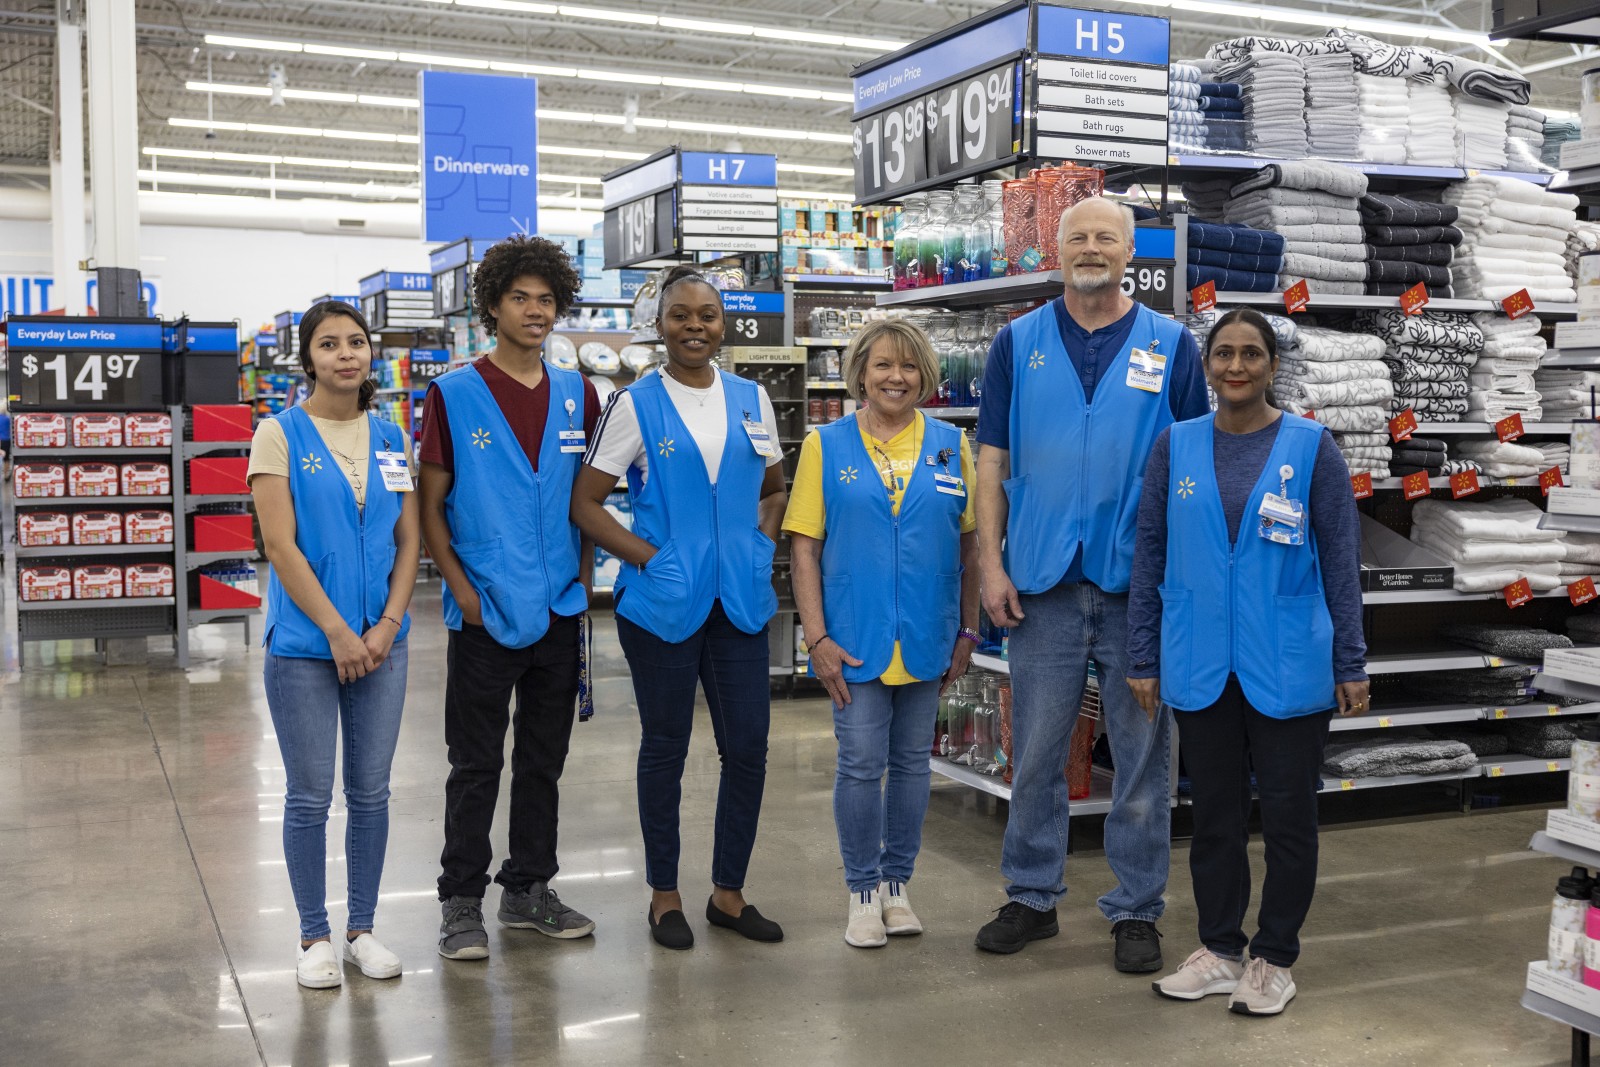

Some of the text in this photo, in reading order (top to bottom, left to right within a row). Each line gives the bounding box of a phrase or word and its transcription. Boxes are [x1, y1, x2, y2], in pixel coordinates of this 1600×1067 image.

[1070, 67, 1137, 83] Toilet lid covers
[858, 66, 922, 100] Everyday Low Price
[1085, 95, 1125, 107] Bath sets
[1082, 120, 1124, 134] Bath rugs
[1075, 145, 1131, 158] Shower mats
[433, 155, 530, 177] Dinnerware
[707, 191, 753, 199] Votive candles
[696, 208, 732, 217] Fragranced
[747, 208, 765, 216] melts
[717, 224, 745, 233] Lamp oil
[705, 240, 757, 249] Scented candles
[723, 293, 755, 303] Everyday
[724, 302, 757, 311] Low Price
[18, 329, 116, 341] Everyday Low Price
